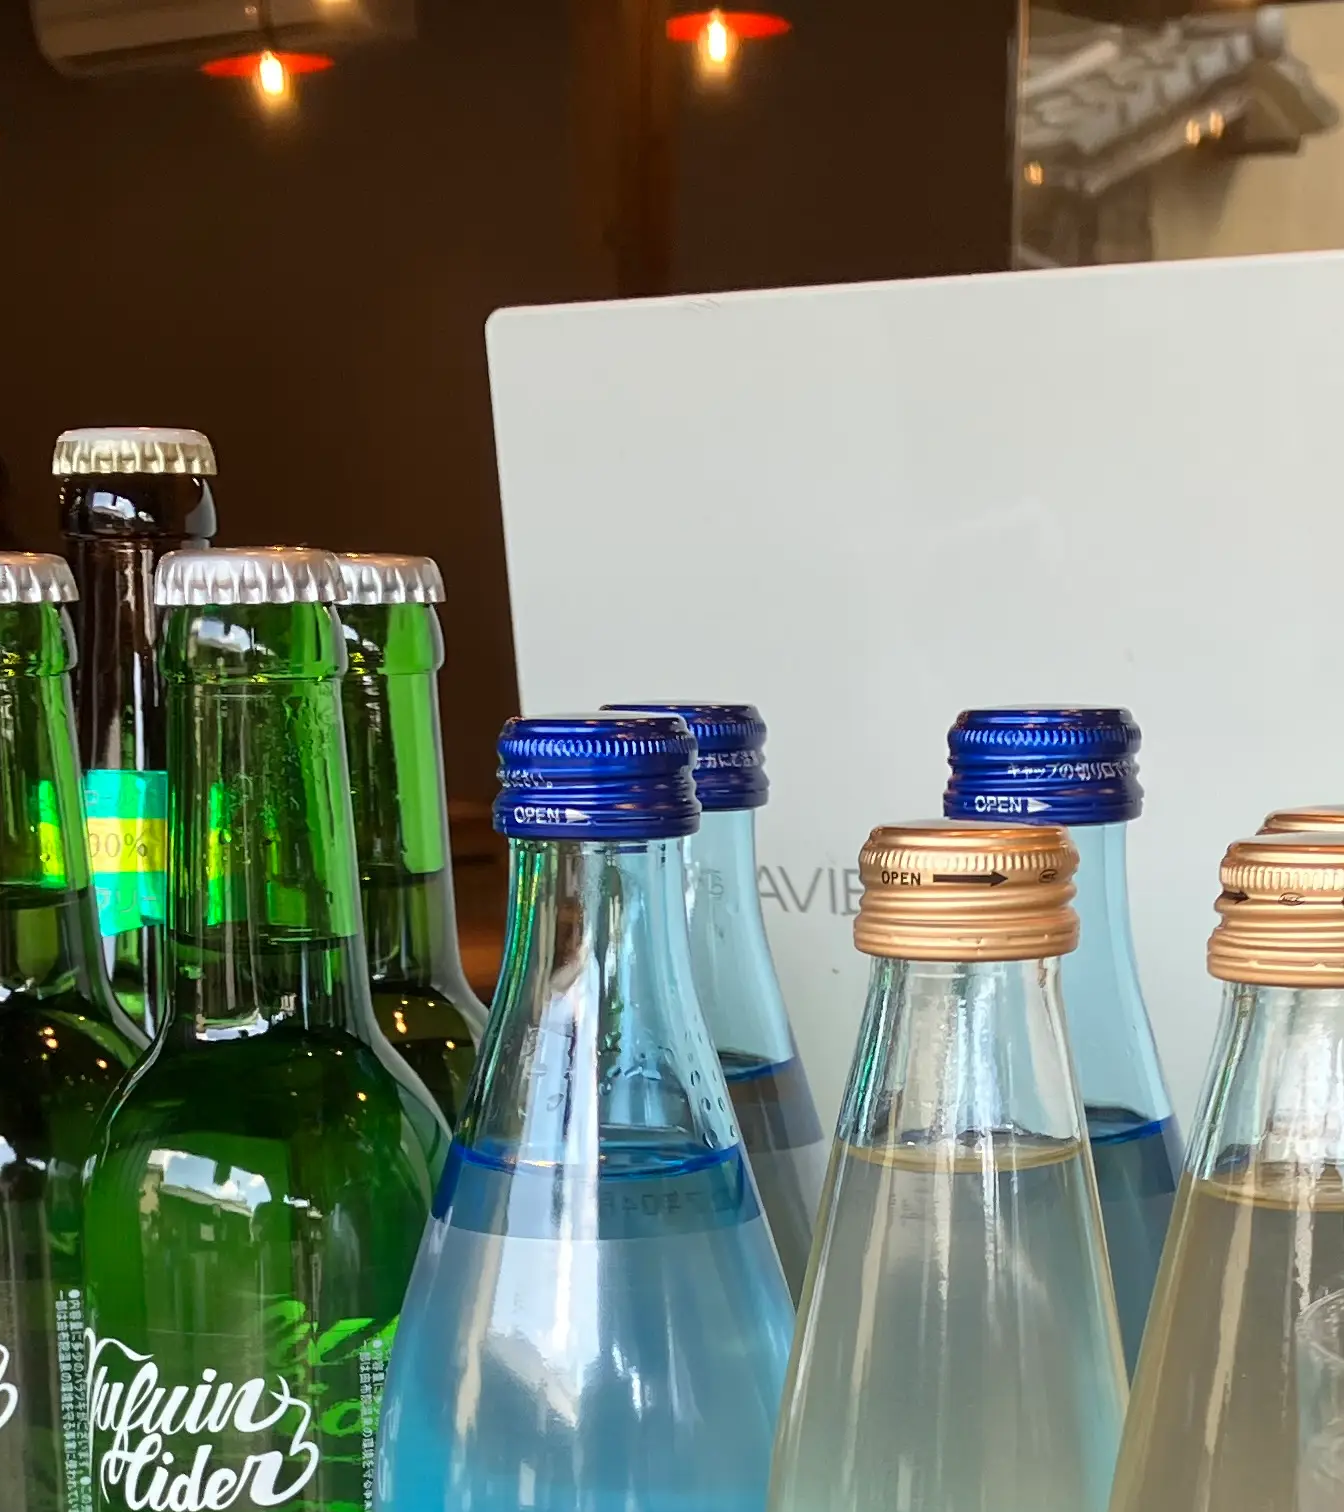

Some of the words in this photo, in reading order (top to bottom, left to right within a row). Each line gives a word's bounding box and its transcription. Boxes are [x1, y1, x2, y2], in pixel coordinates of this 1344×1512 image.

[975, 796, 1022, 813] OPEN
[514, 806, 560, 825] OPEN
[881, 871, 921, 886] OPEN
[100, 1432, 319, 1512] Cider
